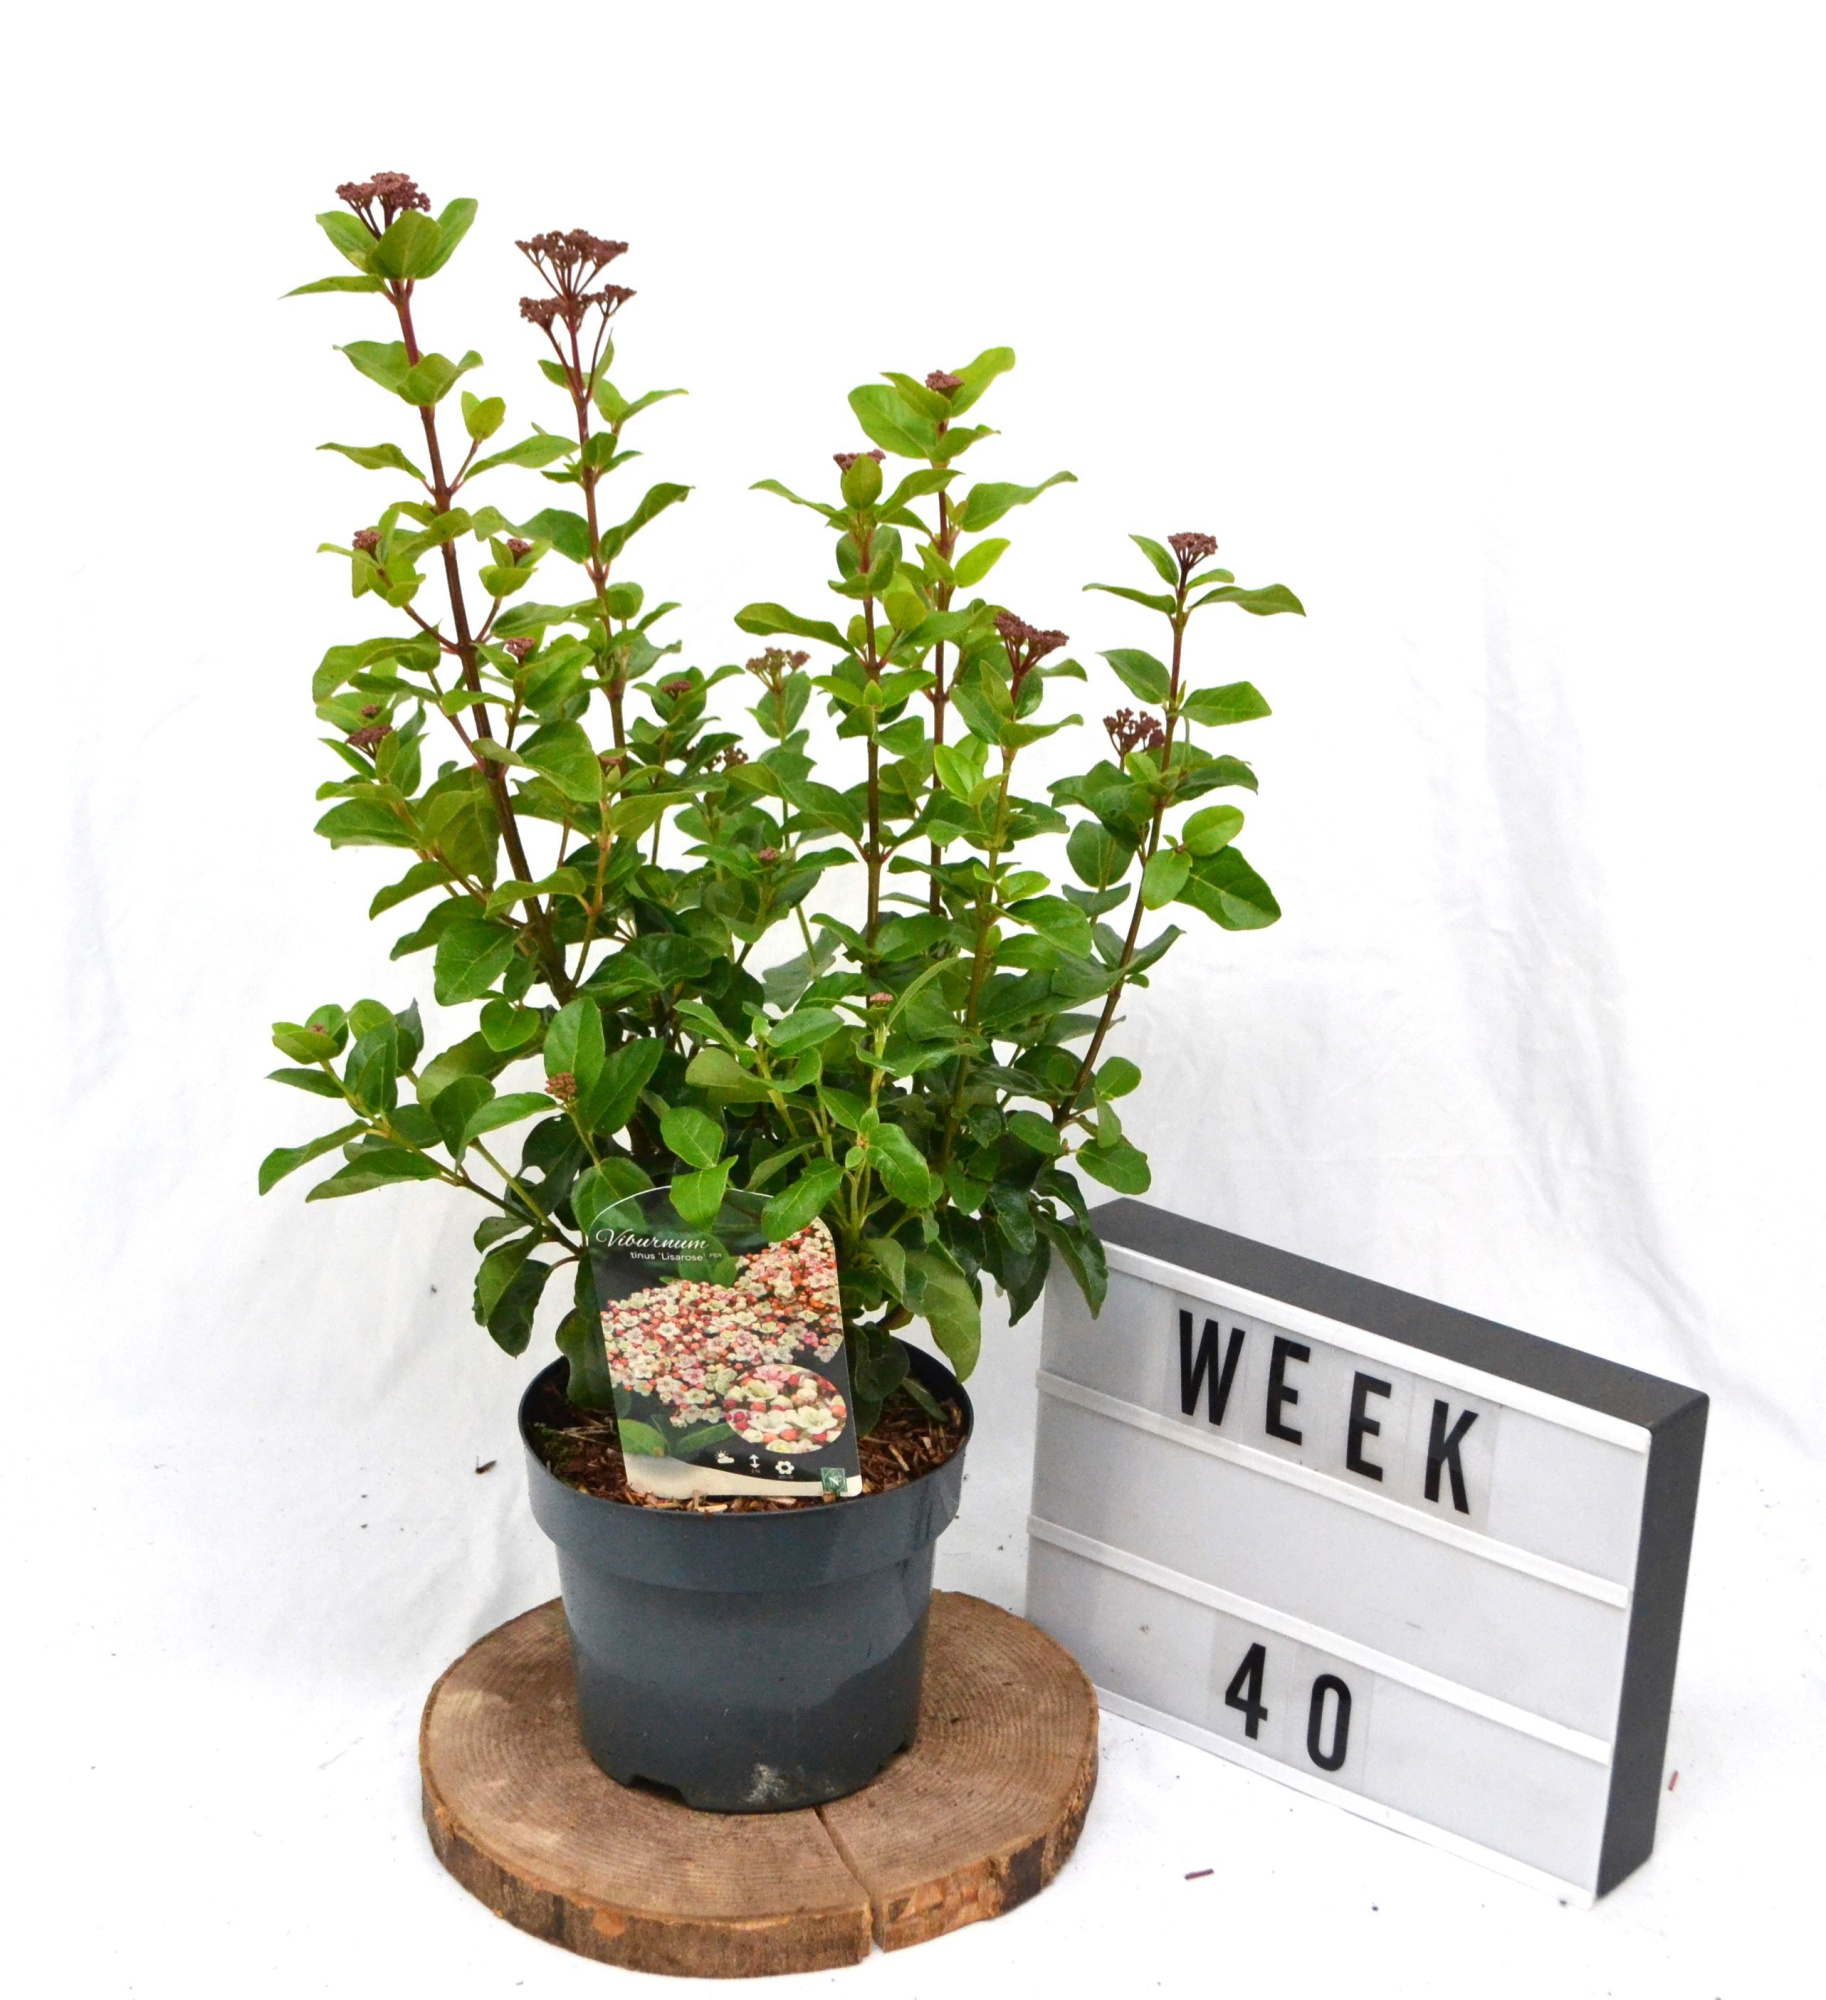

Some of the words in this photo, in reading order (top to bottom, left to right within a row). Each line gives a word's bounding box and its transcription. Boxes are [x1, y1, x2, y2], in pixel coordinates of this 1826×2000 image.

[595, 1228, 709, 1249] Viburnum
[630, 1251, 655, 1260] tinus
[1178, 1309, 1480, 1515] WEEK
[1224, 1643, 1353, 1772] 40
